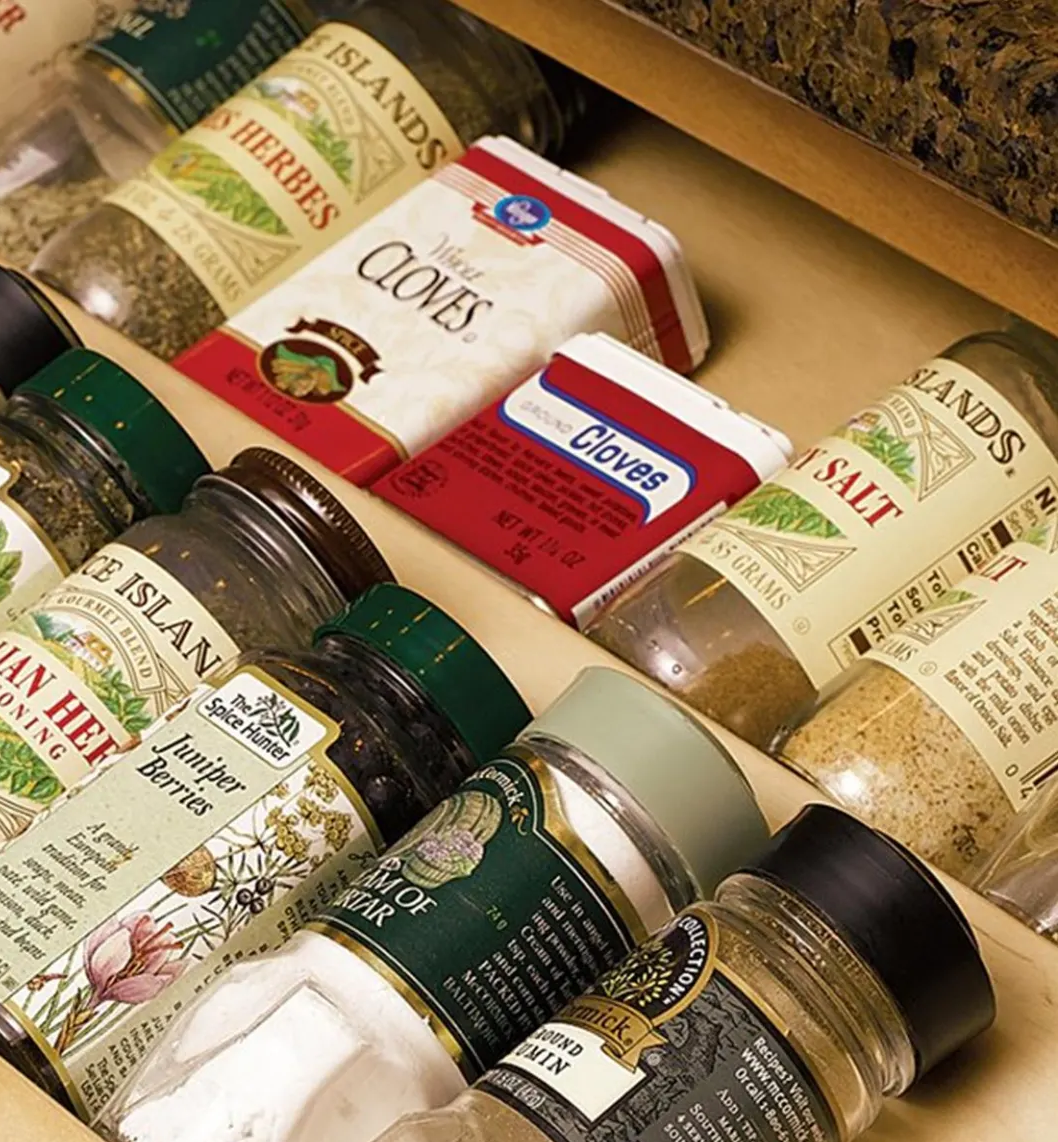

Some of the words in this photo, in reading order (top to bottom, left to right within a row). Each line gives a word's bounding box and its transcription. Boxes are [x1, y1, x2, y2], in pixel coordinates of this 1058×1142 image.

[230, 119, 340, 230] HERBES
[357, 241, 493, 332] CLOVES
[570, 424, 669, 492] Cloves
[814, 457, 904, 527] SALT
[732, 548, 792, 611] GRAMS
[112, 622, 153, 681] BLEND
[229, 692, 253, 713] The
[973, 699, 998, 729] Onion
[204, 698, 247, 738] Spice
[240, 725, 291, 763] Hunter
[1007, 715, 1031, 745] onion
[137, 757, 215, 820] Berries
[154, 732, 247, 796] Juniper
[42, 841, 92, 884] tradition
[88, 873, 110, 896] for
[66, 830, 120, 879] European
[19, 882, 47, 907] wild
[393, 885, 438, 917] OF
[542, 897, 562, 924] and
[552, 875, 574, 904] Use
[520, 924, 553, 970] Cream
[734, 1066, 752, 1085] Or
[743, 1080, 765, 1105] call
[750, 1035, 793, 1087] Recipes?
